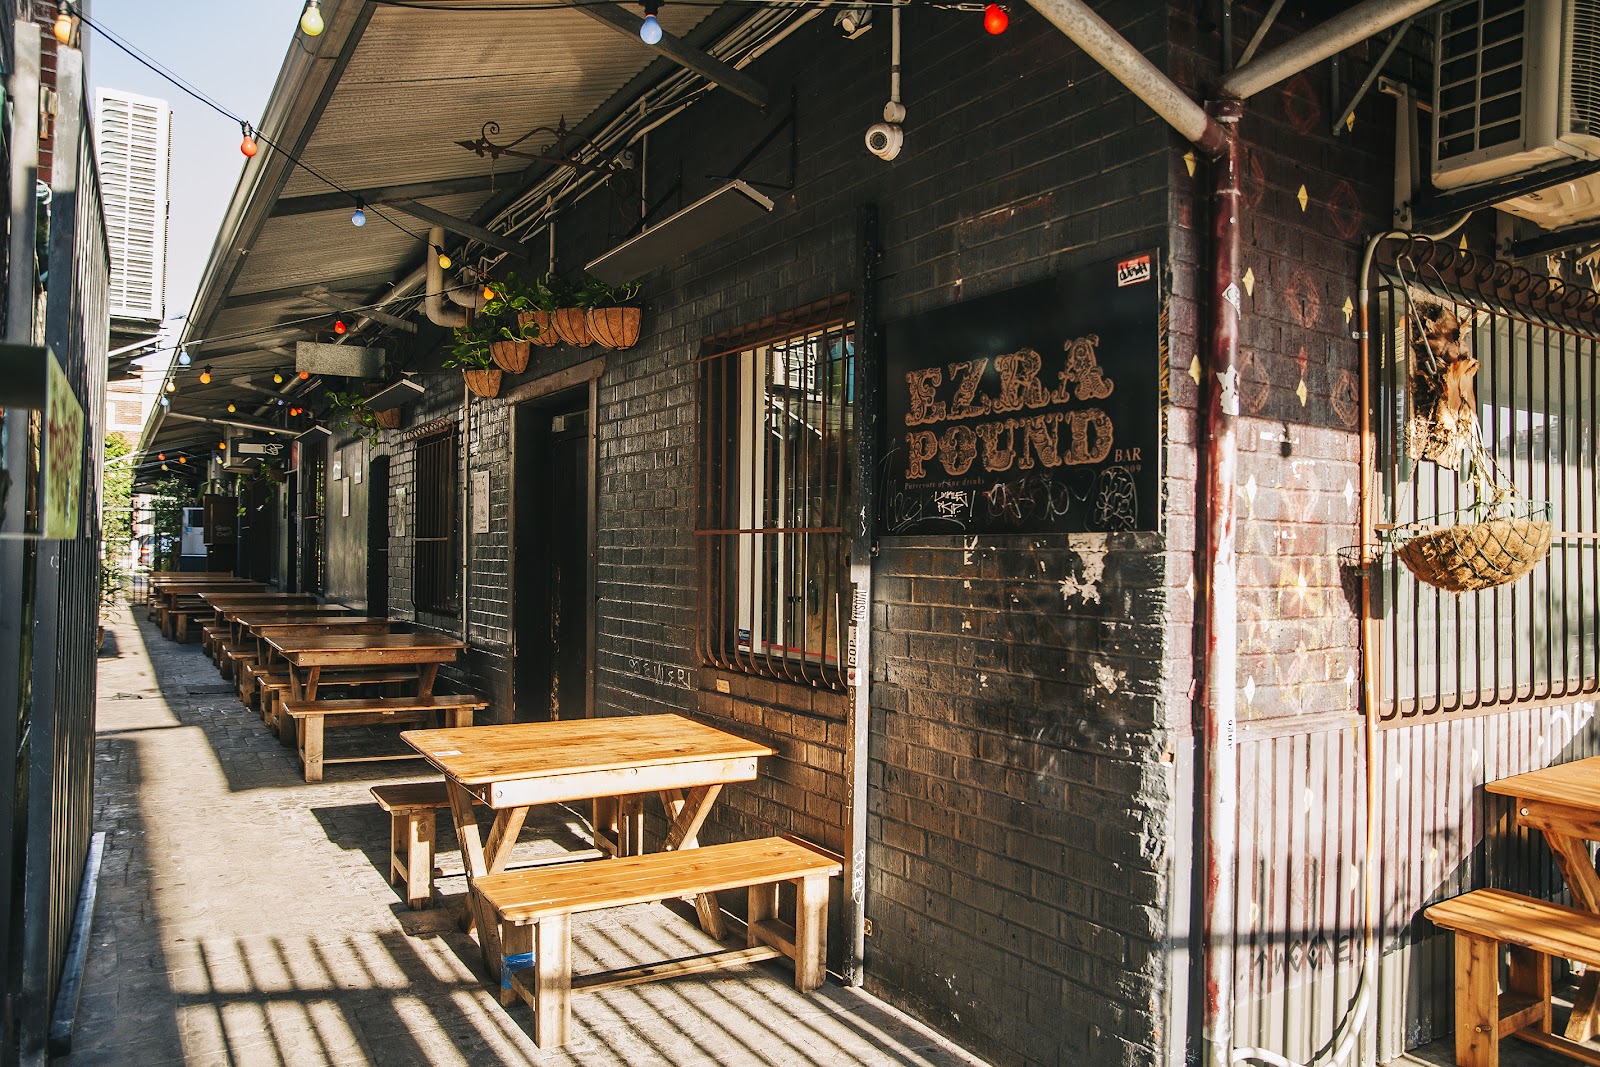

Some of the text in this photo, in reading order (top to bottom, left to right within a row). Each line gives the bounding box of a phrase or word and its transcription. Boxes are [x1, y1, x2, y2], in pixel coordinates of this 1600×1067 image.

[905, 334, 1115, 427] EZRA
[905, 407, 1115, 480] POUND
[1114, 447, 1142, 463] BAR
[962, 476, 985, 486] drinks
